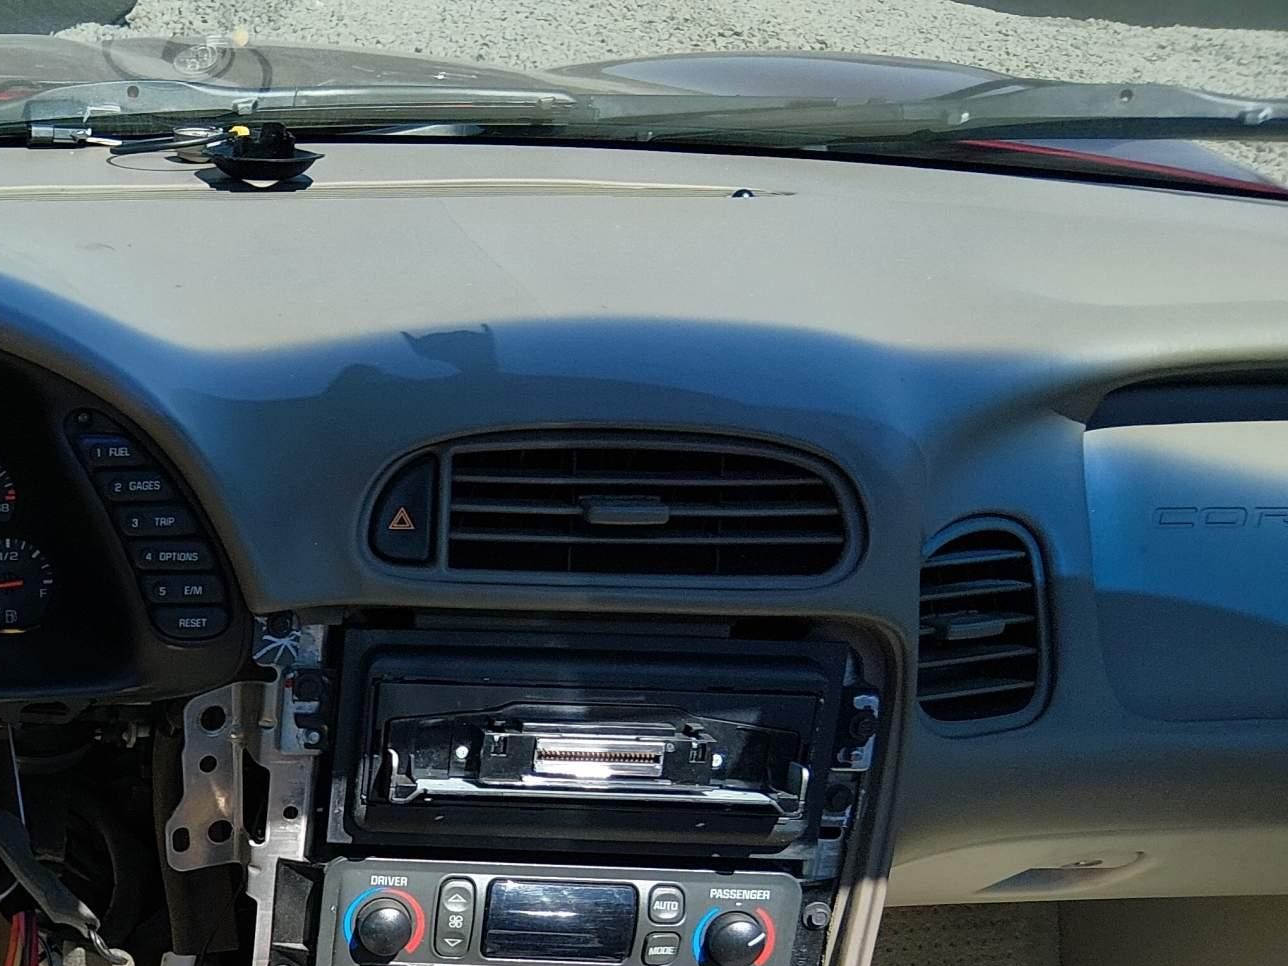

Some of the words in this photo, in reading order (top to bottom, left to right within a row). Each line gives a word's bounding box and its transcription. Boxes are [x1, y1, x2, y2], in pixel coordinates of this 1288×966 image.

[109, 447, 131, 457] FUEL
[114, 483, 122, 492] 2
[129, 481, 161, 491] GAGES
[132, 518, 139, 527] 3
[154, 517, 175, 526] TRIP
[0, 551, 19, 561] 1/2
[145, 552, 152, 561] 4
[159, 552, 198, 562] OPTIONS
[40, 588, 48, 598] F
[159, 586, 166, 596] 5
[184, 586, 202, 596] E/M
[179, 618, 207, 628] RESET
[370, 875, 408, 887] DRIVER
[709, 888, 771, 901] PASSENGER
[653, 899, 679, 911] AUTO
[648, 945, 674, 956] MODE
